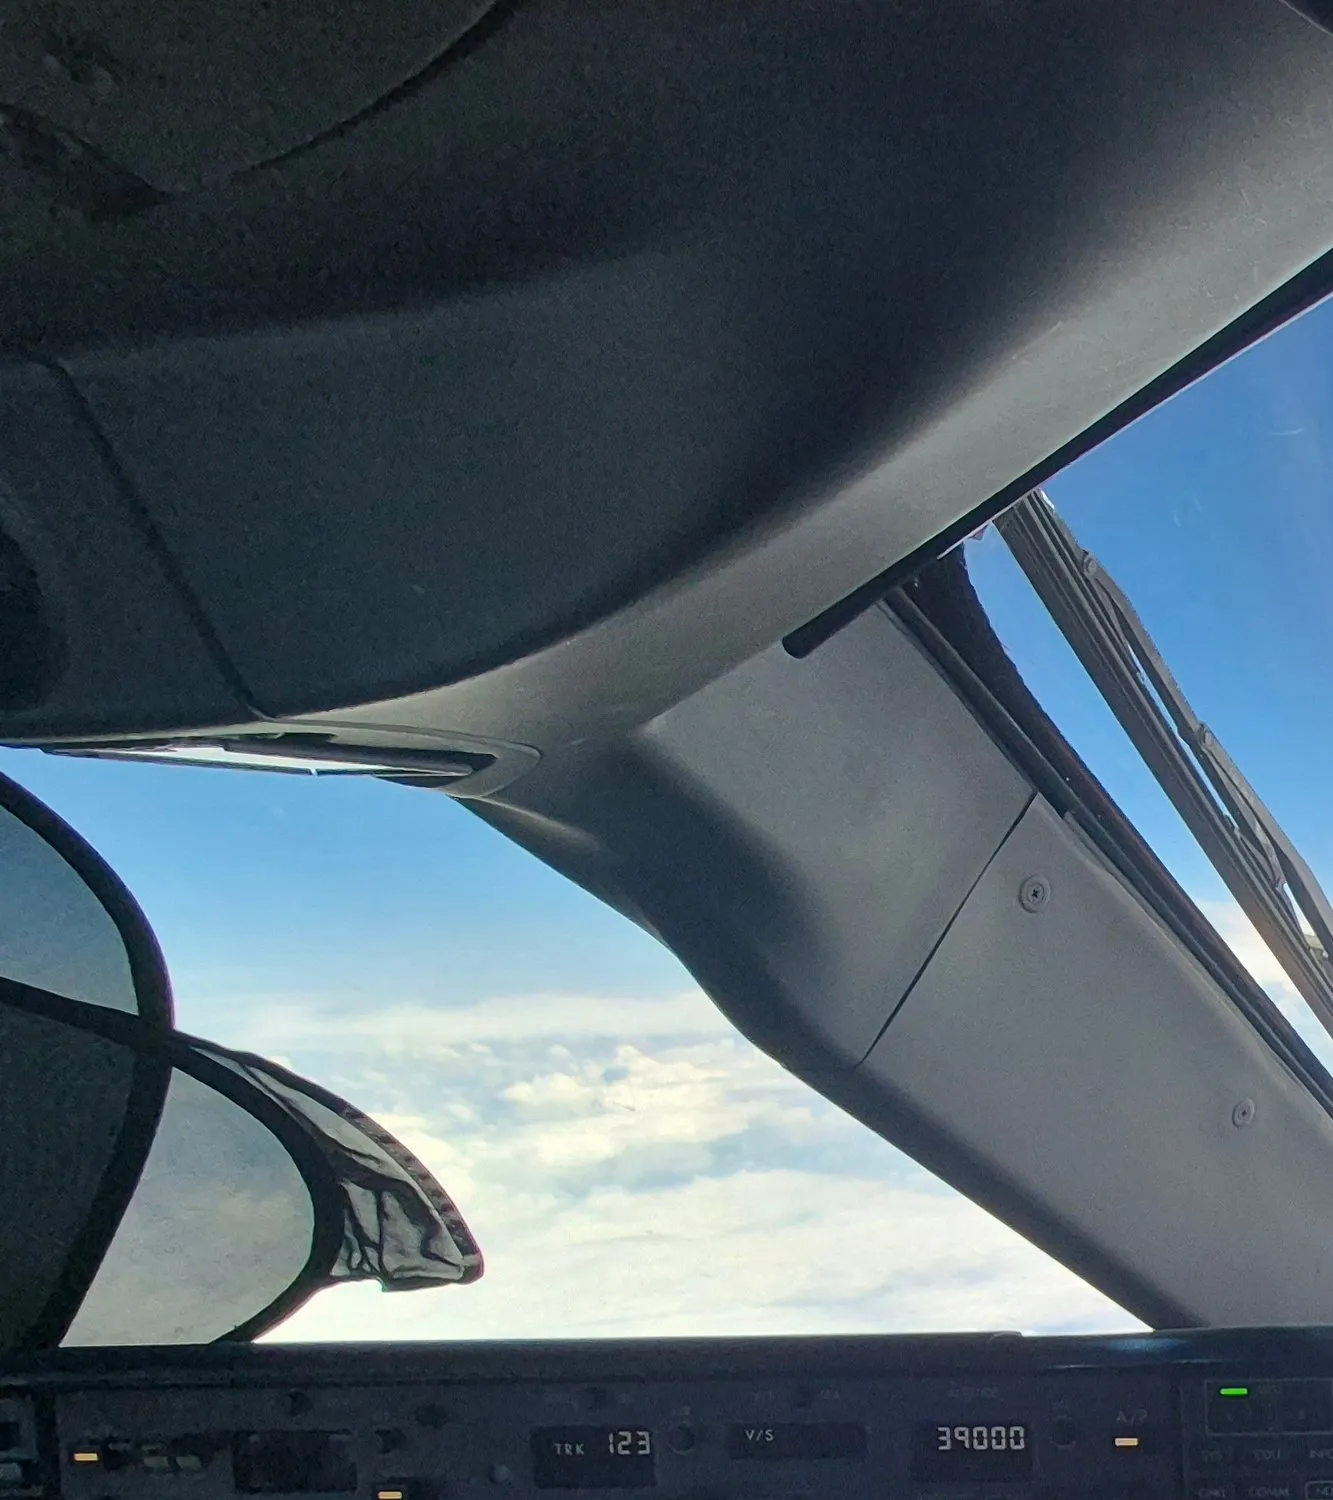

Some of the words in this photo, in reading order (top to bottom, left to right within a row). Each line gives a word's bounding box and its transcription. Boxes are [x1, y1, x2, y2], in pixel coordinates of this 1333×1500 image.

[555, 1443, 585, 1456] TRK
[608, 1431, 651, 1455] 123
[744, 1429, 775, 1442] V/S
[937, 1426, 1026, 1450] 39000
